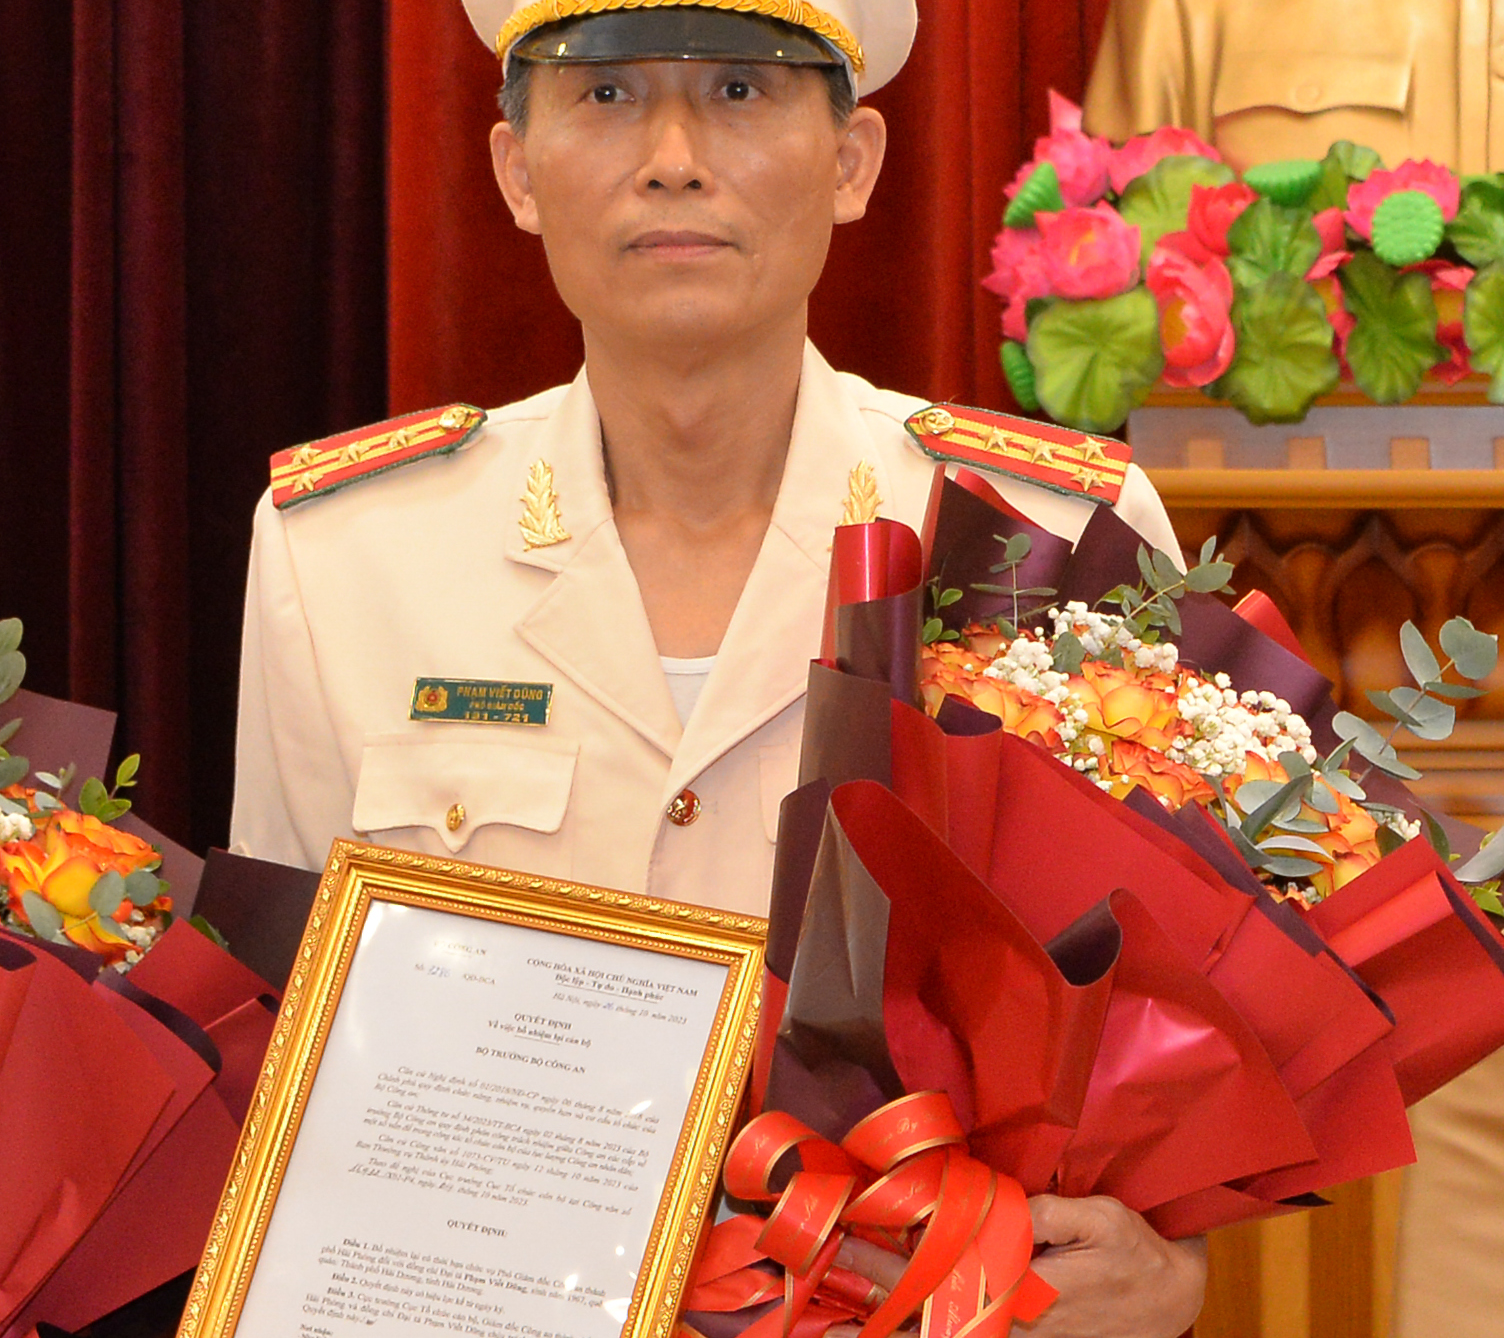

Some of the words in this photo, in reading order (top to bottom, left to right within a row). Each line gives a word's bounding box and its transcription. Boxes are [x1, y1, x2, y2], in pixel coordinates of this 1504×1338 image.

[675, 985, 699, 998] NAM
[512, 1011, 547, 1026] QUYẾT
[546, 1018, 572, 1031] ĐỊNH
[474, 1045, 490, 1056] BỘ
[488, 1047, 530, 1064] TRƯỞNG
[528, 1055, 545, 1066] BỘ
[542, 1058, 572, 1072] CÔNG
[571, 1064, 586, 1075] AN
